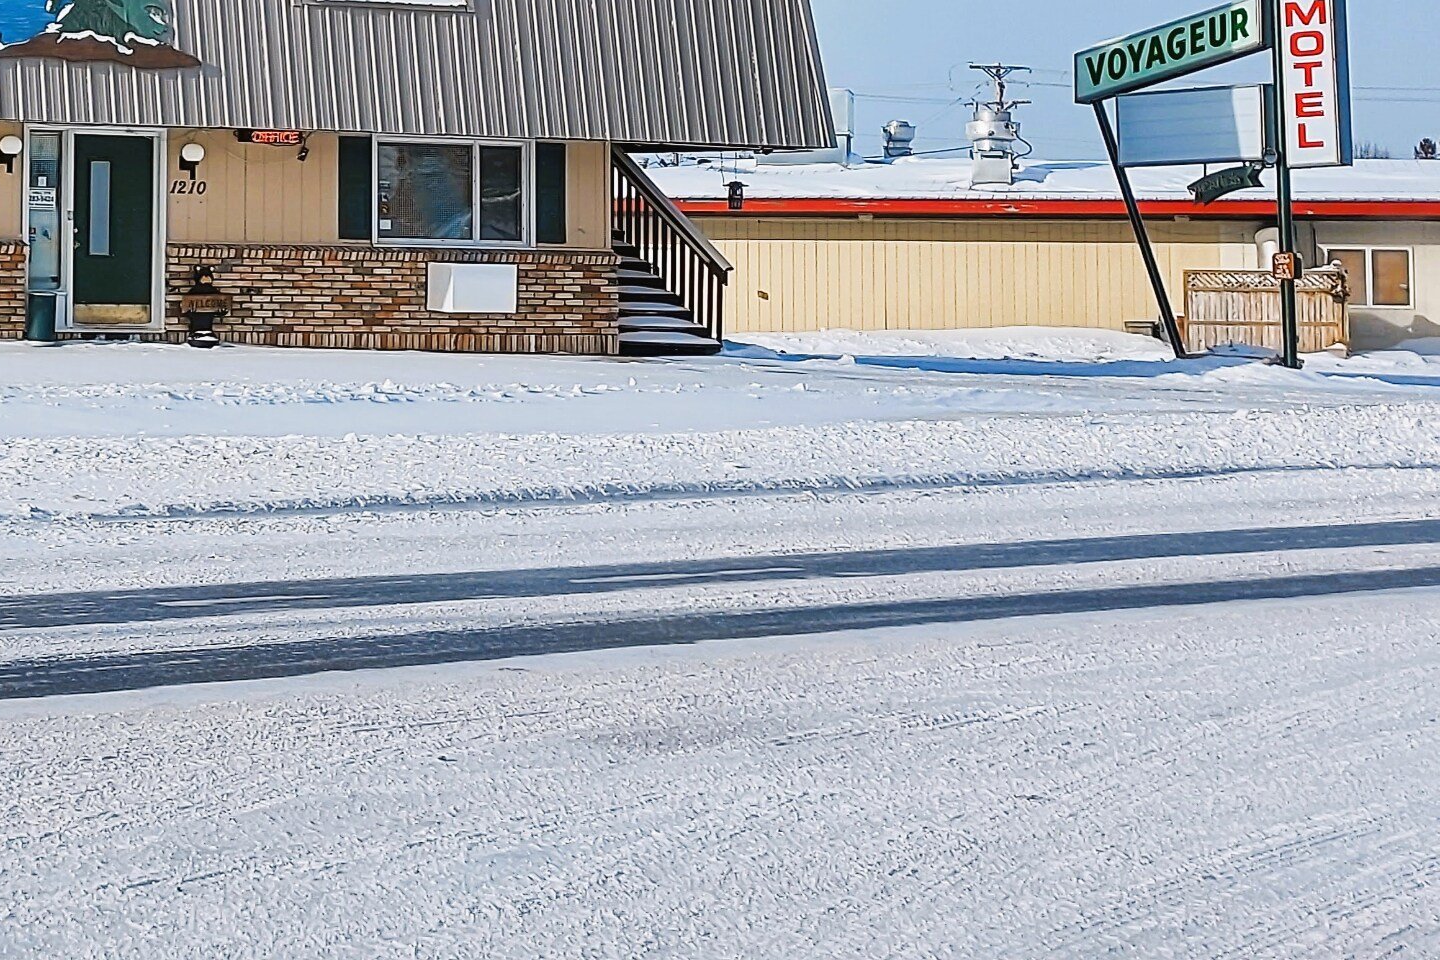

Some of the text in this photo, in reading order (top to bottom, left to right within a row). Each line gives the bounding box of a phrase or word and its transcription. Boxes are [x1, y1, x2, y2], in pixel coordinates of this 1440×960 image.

[1085, 7, 1249, 87] VOYAGEUR
[251, 131, 300, 143] OFFICE
[170, 180, 207, 195] 1210
